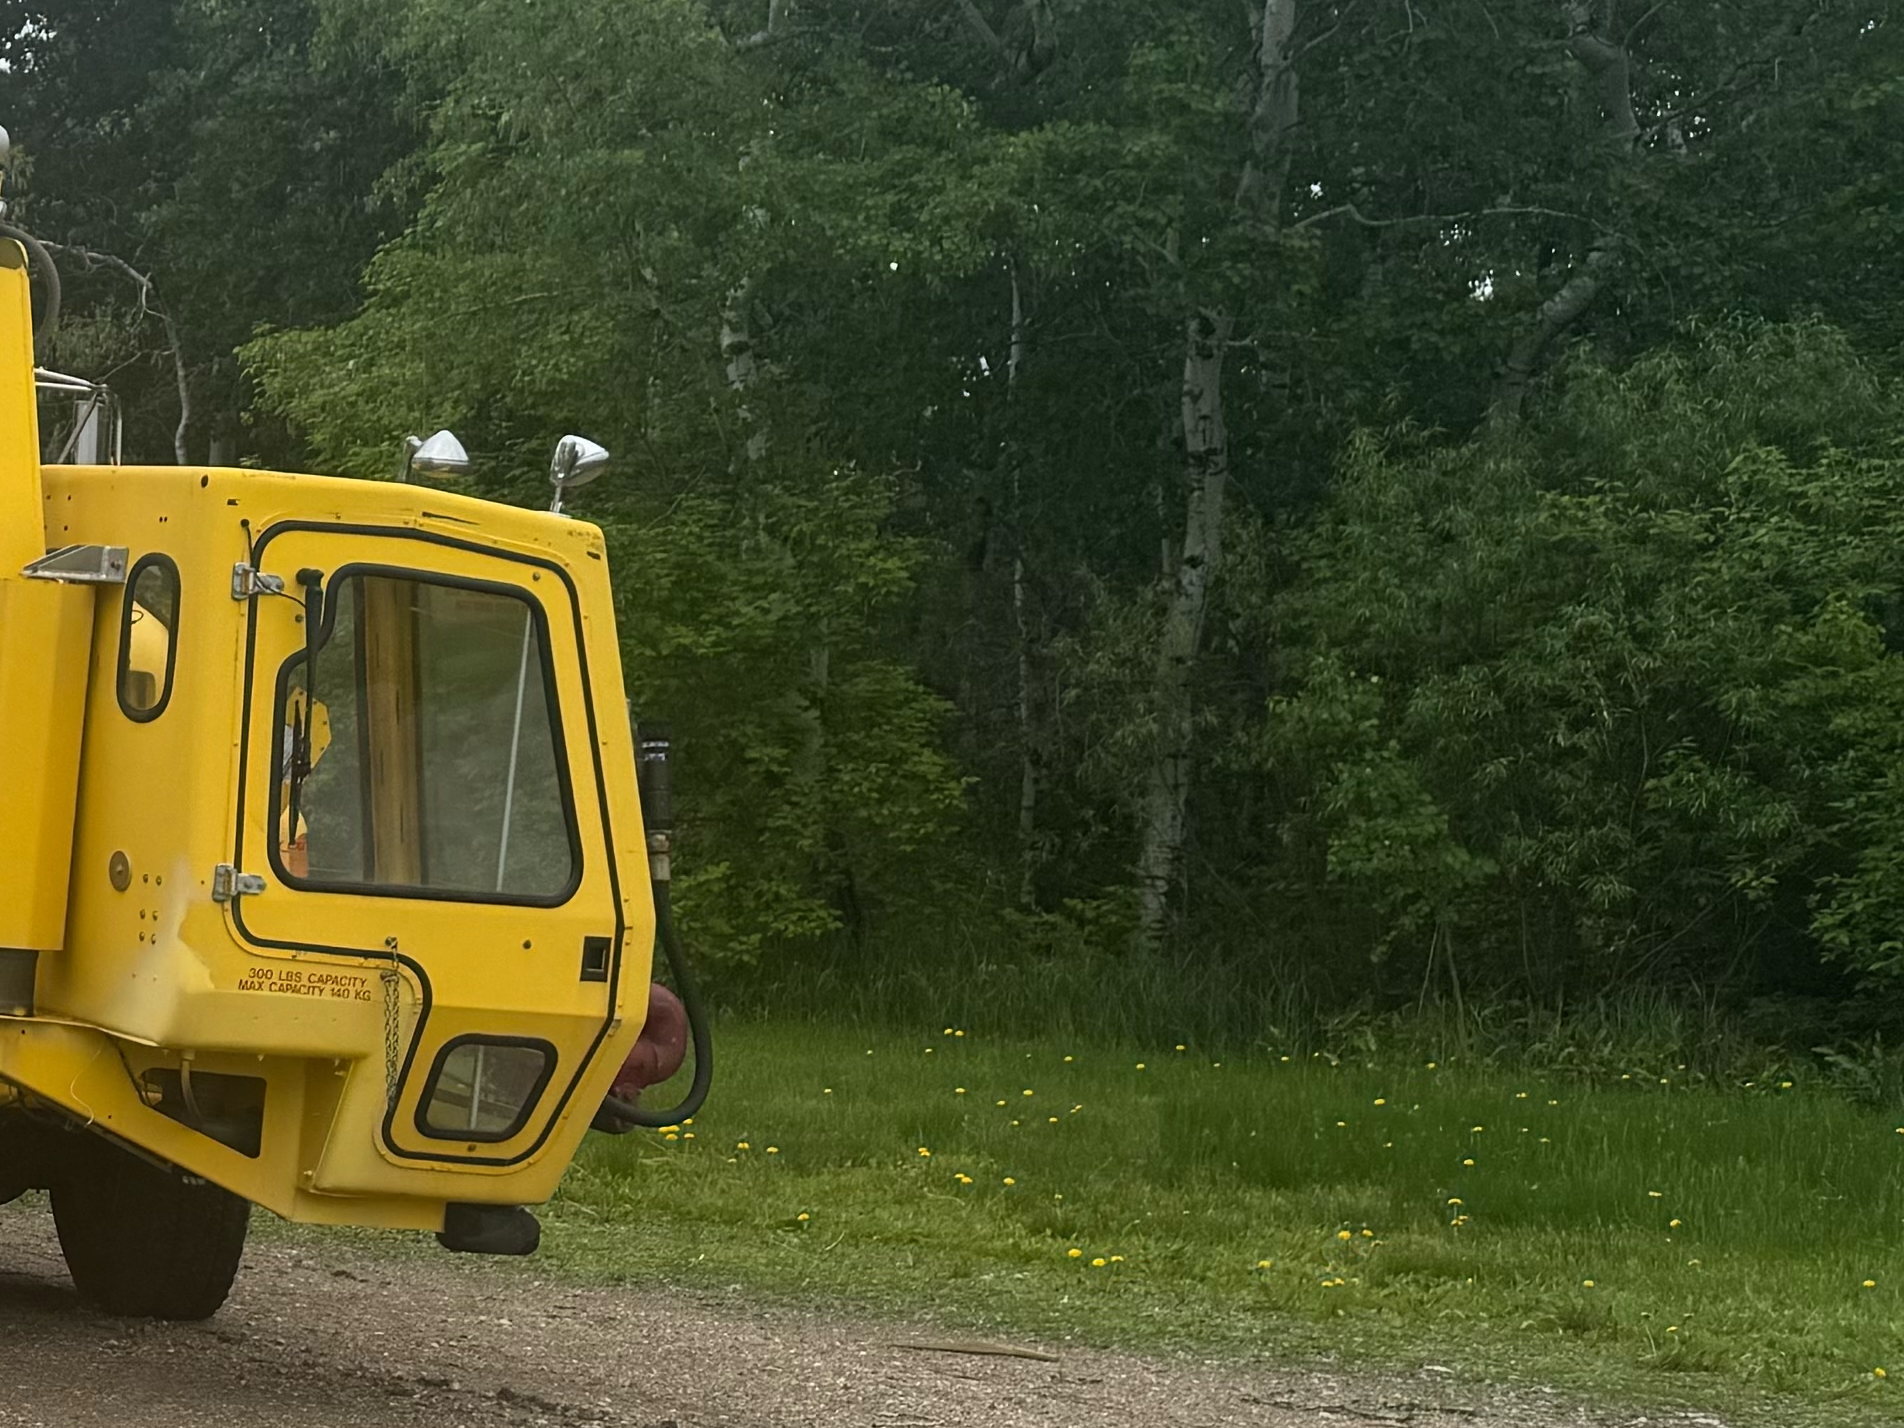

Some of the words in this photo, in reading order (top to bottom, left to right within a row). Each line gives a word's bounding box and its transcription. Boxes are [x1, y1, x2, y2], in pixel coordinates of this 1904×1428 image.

[248, 968, 273, 980] 300
[279, 970, 303, 983] LBS
[308, 973, 367, 988] CAPACITY
[238, 979, 265, 992] MAX
[269, 981, 325, 997] CAPACITY
[330, 987, 350, 999] 140
[354, 990, 371, 1001] KG
